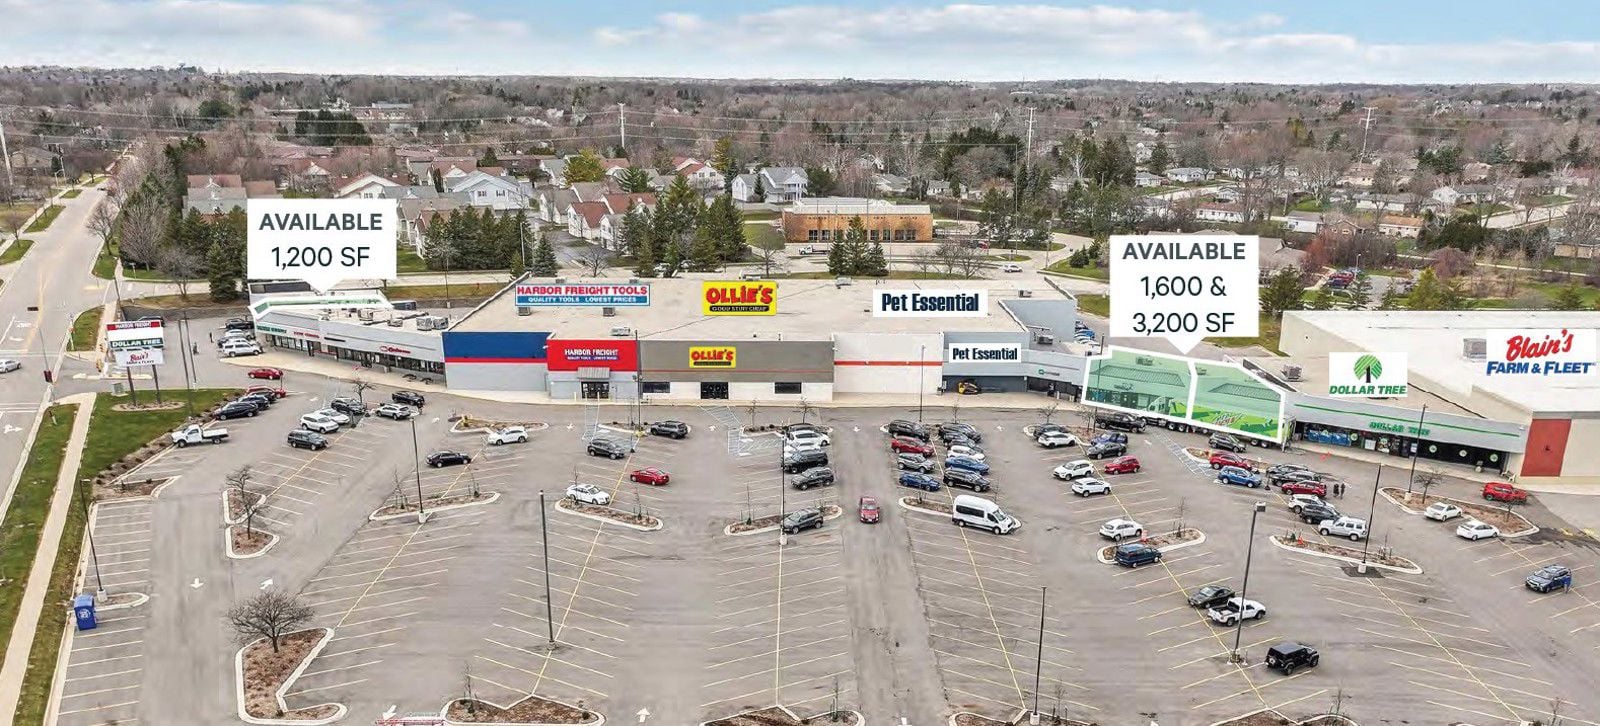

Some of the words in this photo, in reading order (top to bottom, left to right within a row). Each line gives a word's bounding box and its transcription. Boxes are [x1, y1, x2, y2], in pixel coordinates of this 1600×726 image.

[112, 340, 142, 348] DOLLAR
[952, 347, 969, 361] Pet
[971, 347, 1018, 361] Essential
